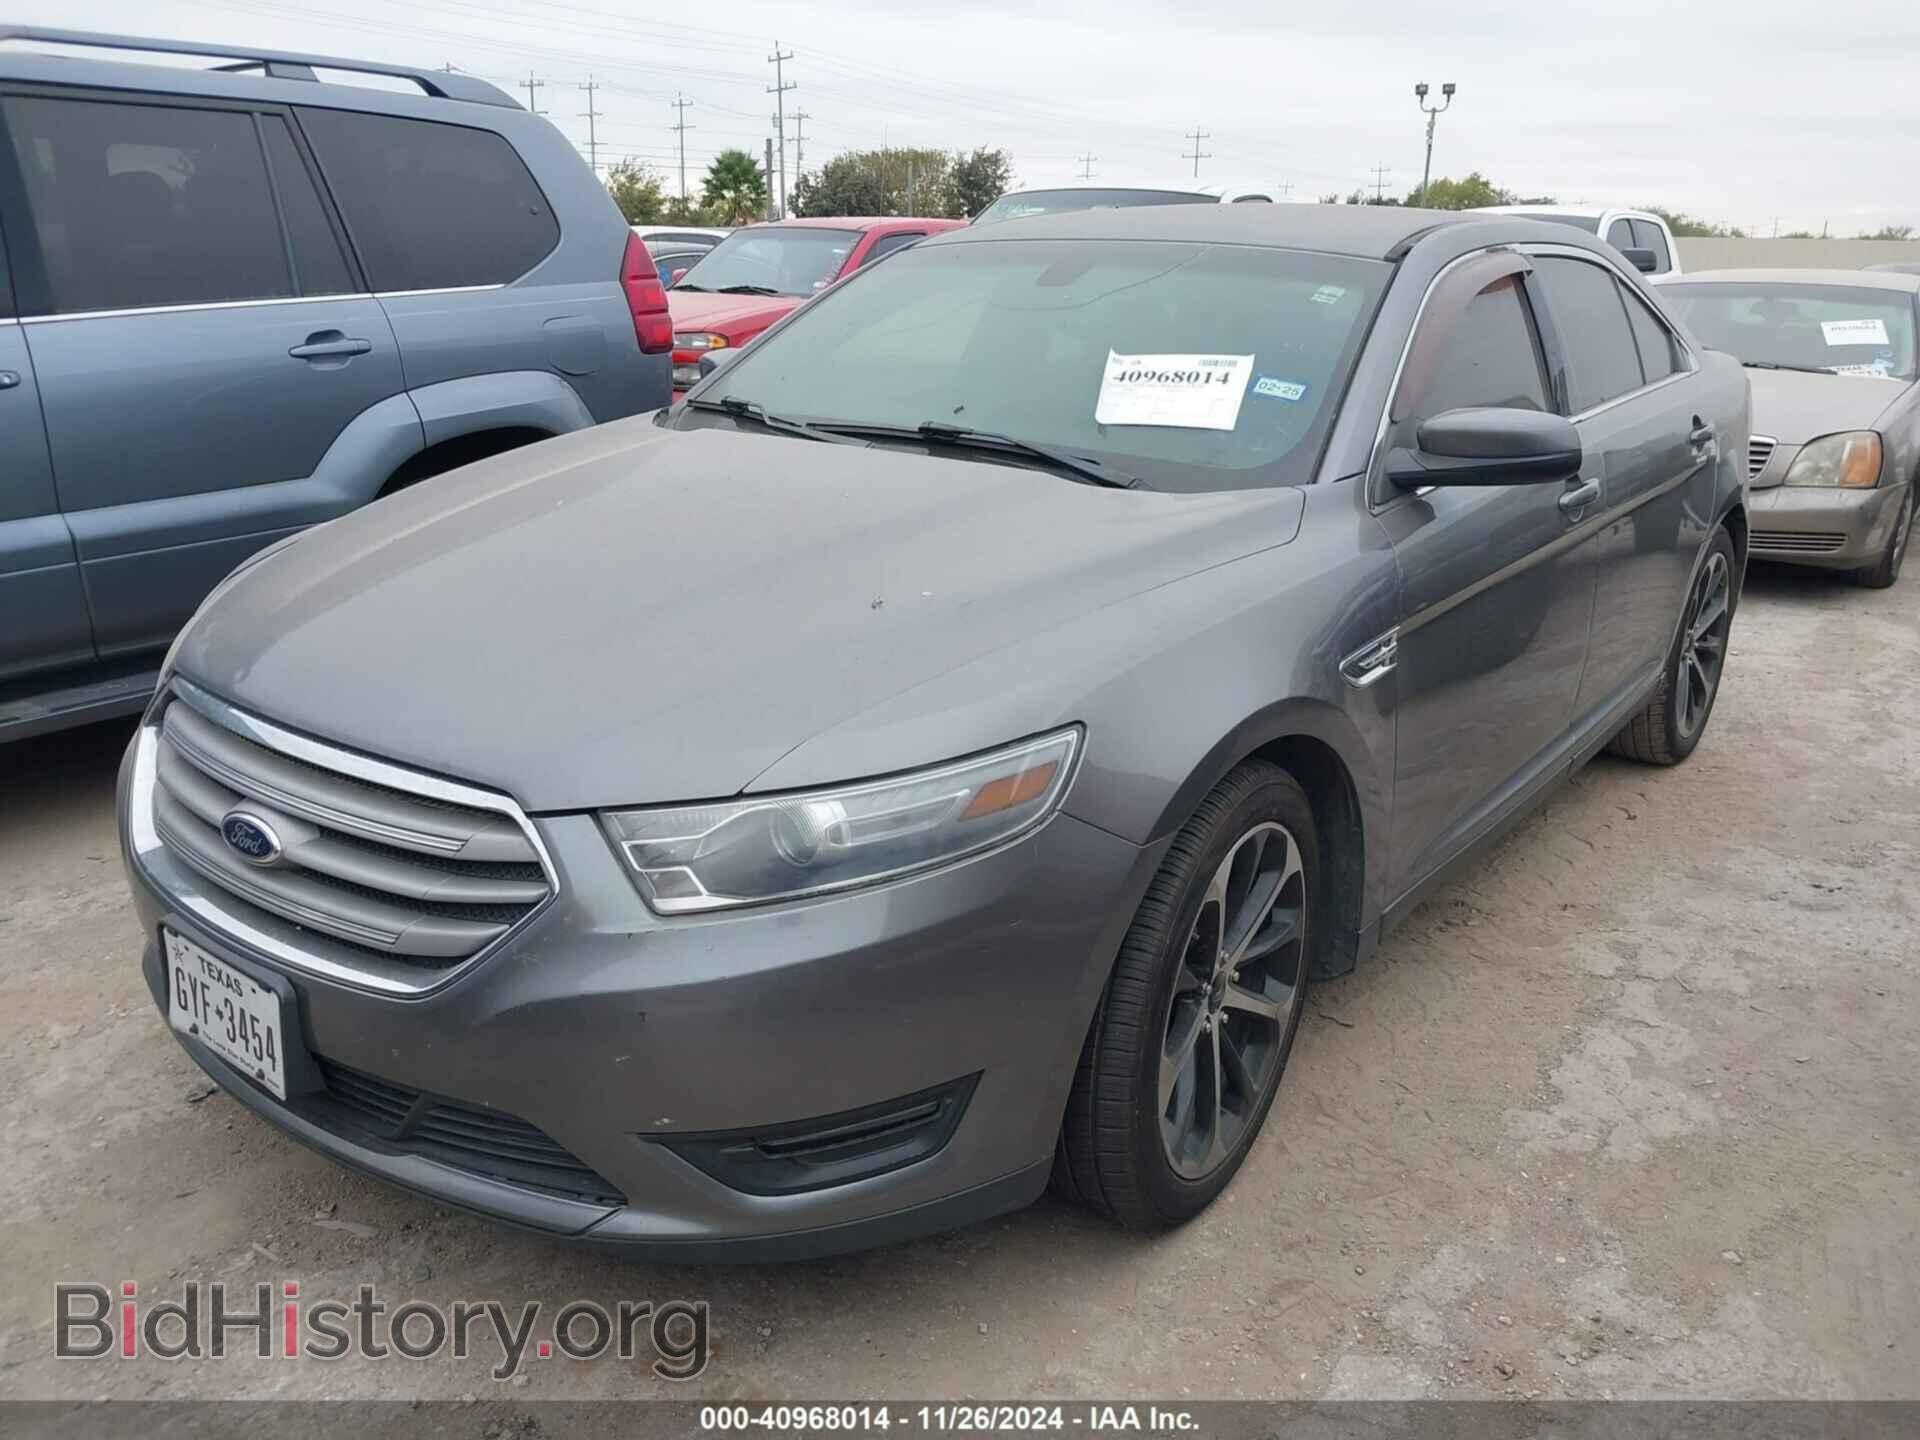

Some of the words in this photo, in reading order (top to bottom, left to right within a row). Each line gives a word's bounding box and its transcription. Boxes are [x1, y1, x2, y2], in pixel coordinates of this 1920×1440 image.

[1112, 370, 1231, 385] 40968014
[231, 822, 263, 854] Ford
[199, 955, 243, 997] TEXAS
